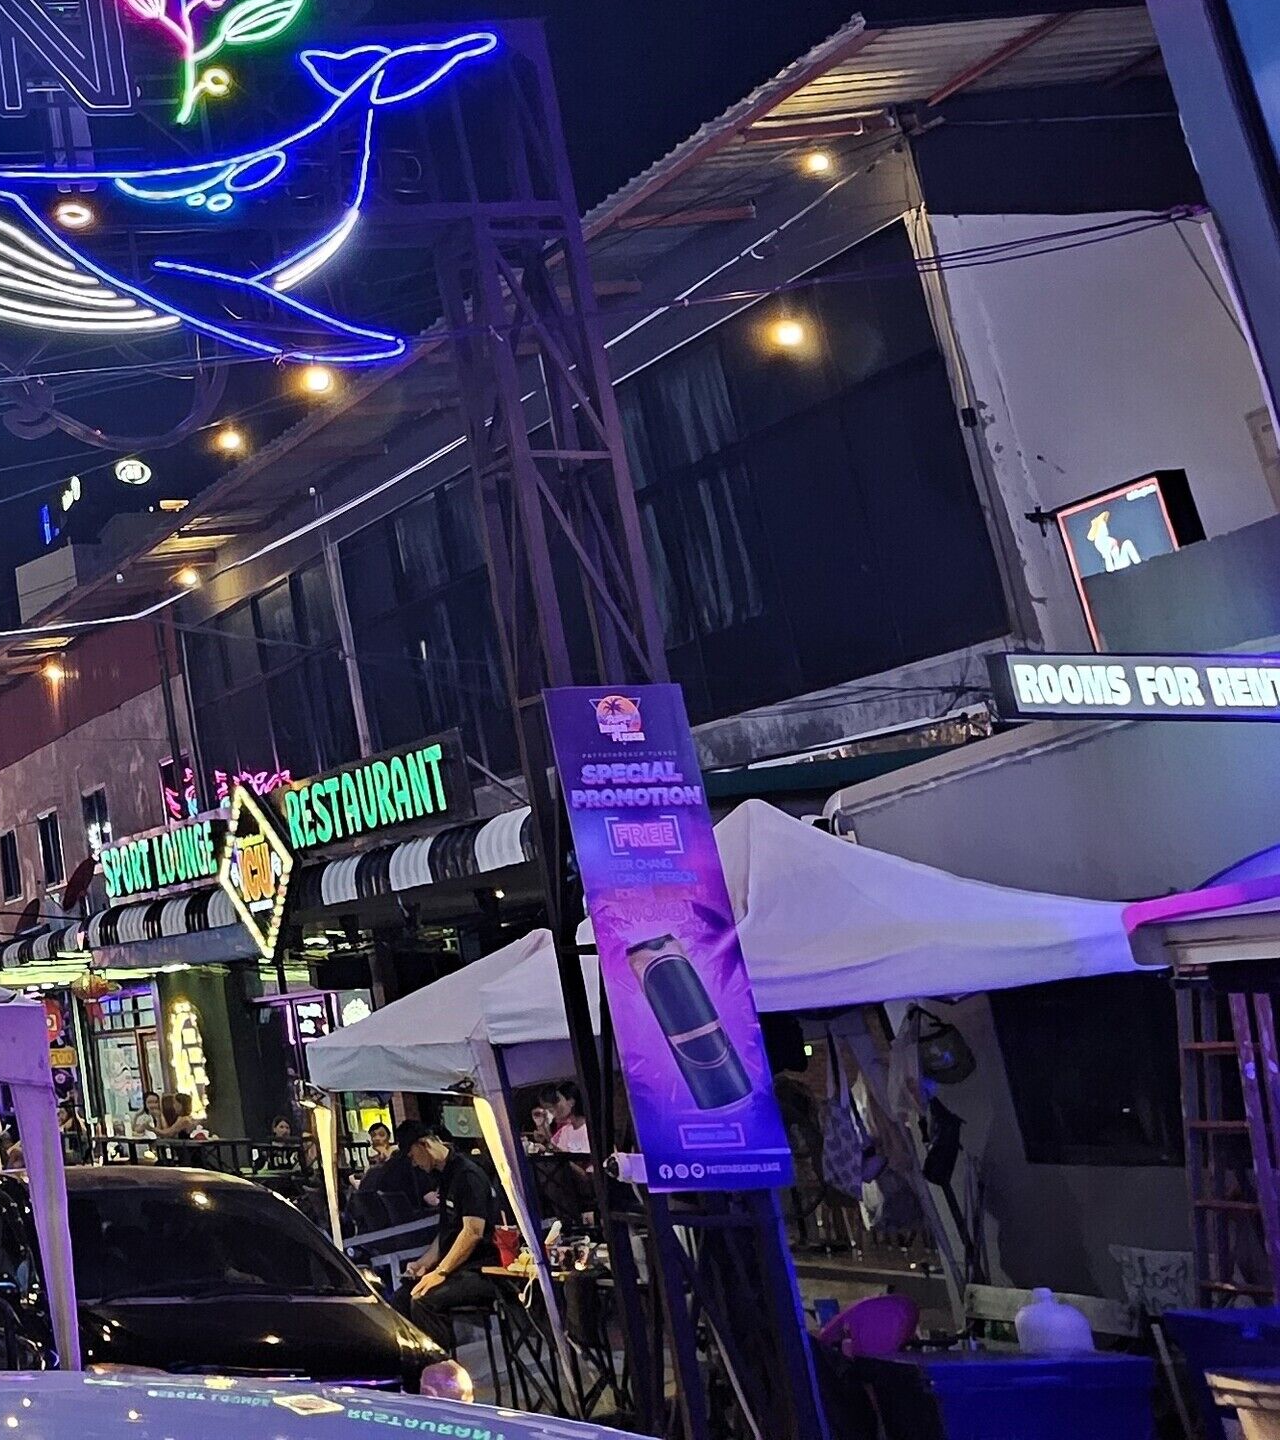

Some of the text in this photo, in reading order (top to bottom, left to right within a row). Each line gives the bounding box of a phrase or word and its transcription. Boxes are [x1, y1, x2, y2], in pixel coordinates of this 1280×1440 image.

[1013, 664, 1132, 705] ROOMS
[1134, 666, 1205, 706] FOR
[581, 761, 683, 785] SPECIAL
[284, 744, 448, 850] RESTAURANT
[571, 785, 702, 808] PROMOTION
[612, 822, 676, 848] FREE
[100, 819, 217, 898] SPORT LOUNGE
